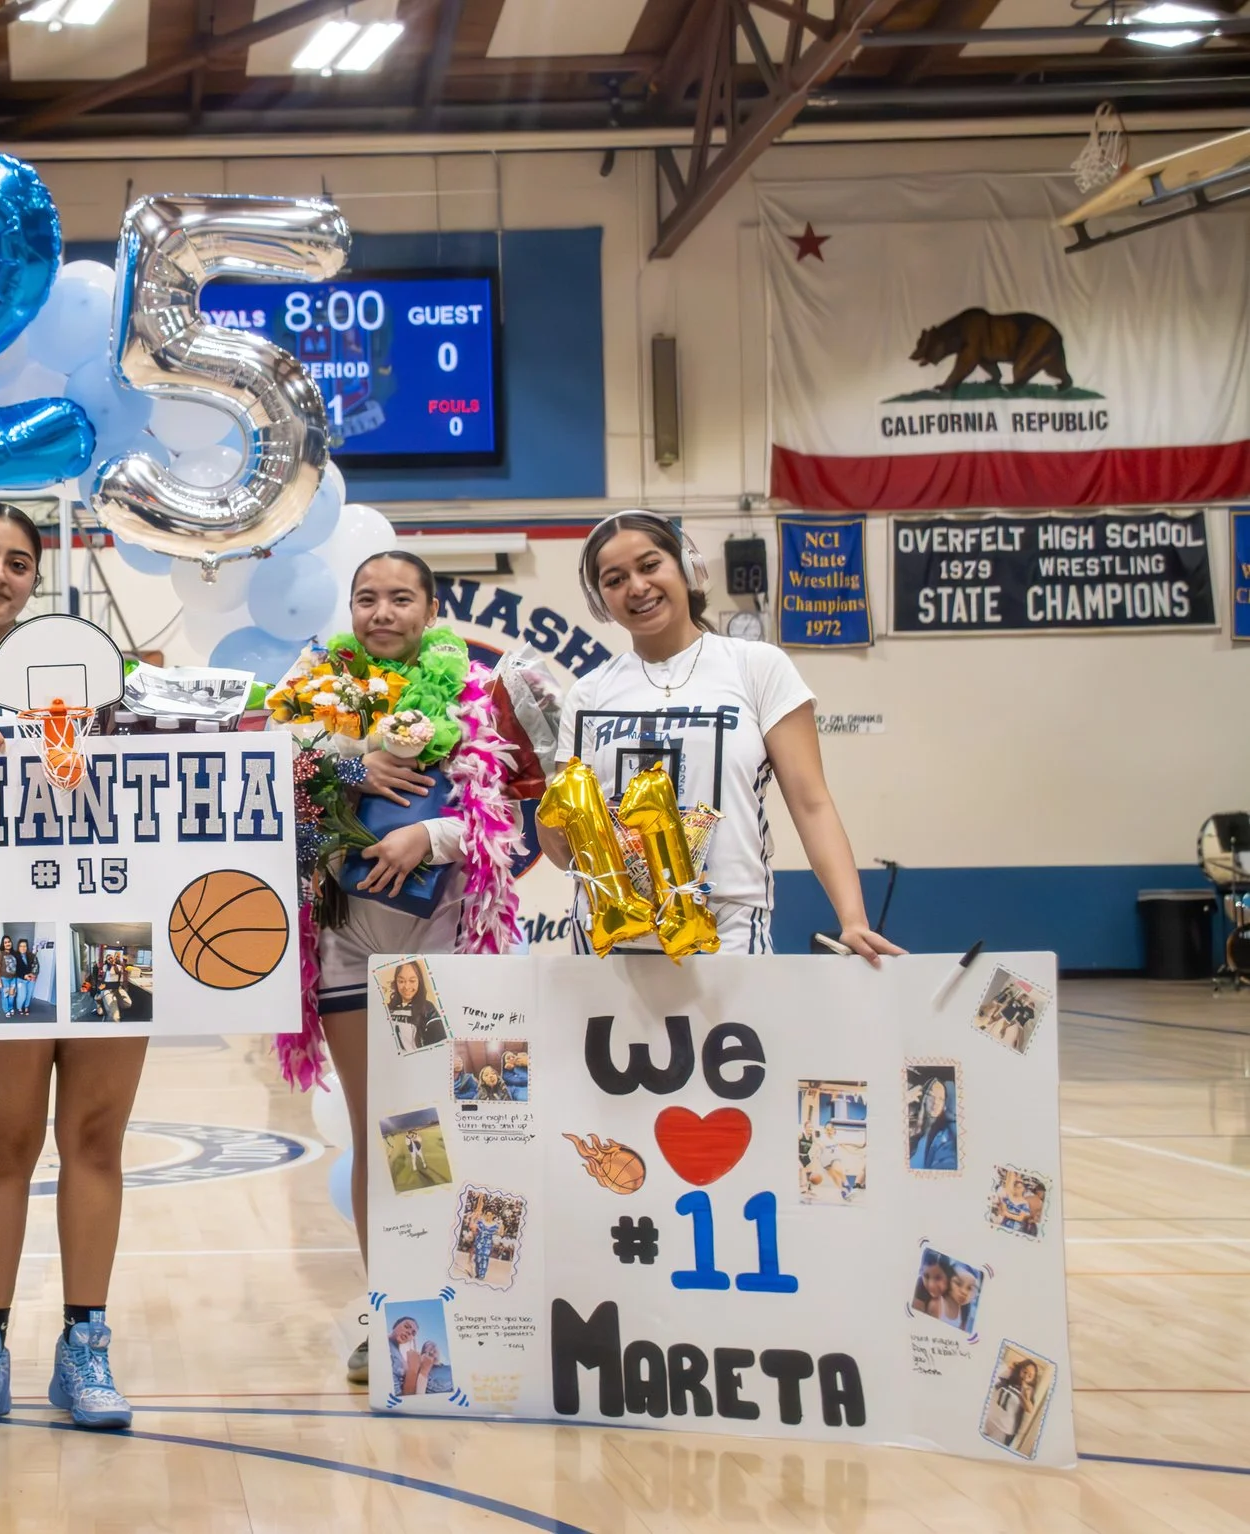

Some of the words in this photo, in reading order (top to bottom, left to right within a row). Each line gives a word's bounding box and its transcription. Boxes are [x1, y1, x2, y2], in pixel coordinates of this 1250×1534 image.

[284, 289, 385, 333] 8:00
[407, 304, 483, 326] GUEST
[437, 341, 459, 372] 0
[327, 394, 344, 426] 1
[428, 399, 481, 415] FOULS
[448, 416, 464, 437] 0
[881, 411, 998, 438] CALIFORNIA
[1012, 410, 1109, 433] REPUBLIC
[897, 525, 1026, 554] OVERFELT
[1038, 525, 1094, 551] HIGH
[1105, 522, 1205, 549] SCHOOL
[800, 551, 846, 568] State
[939, 559, 992, 580] 1979
[1038, 553, 1165, 578] WRESTLING
[789, 570, 861, 590] Wrestling
[783, 595, 866, 616] Champions
[918, 585, 1002, 625] STATE
[1026, 580, 1190, 622] CHAMPIONS
[805, 619, 842, 637] 1972
[30, 859, 61, 890] #
[77, 857, 128, 894] 15
[462, 1005, 488, 1019] TURN
[492, 1012, 505, 1021] UP
[509, 1011, 525, 1025] #11
[584, 1015, 766, 1101] We
[454, 1111, 483, 1122] Senior
[486, 1113, 508, 1124] night
[462, 1134, 480, 1142] love
[483, 1135, 499, 1145] you
[500, 1134, 531, 1145] always
[670, 1190, 799, 1294] 11
[453, 1313, 464, 1322] So
[464, 1314, 487, 1323] happy
[550, 1297, 867, 1428] MARETA
